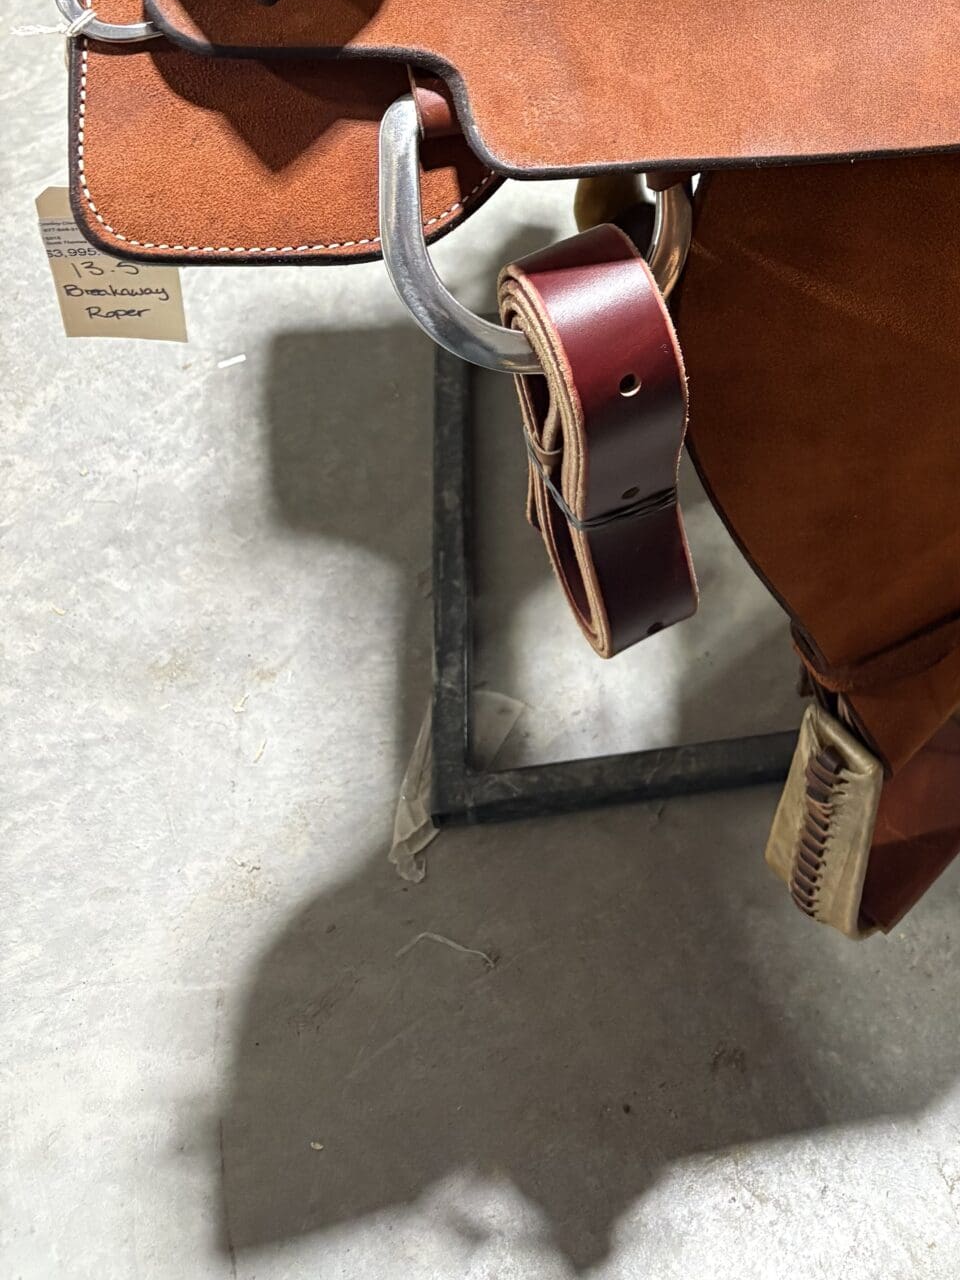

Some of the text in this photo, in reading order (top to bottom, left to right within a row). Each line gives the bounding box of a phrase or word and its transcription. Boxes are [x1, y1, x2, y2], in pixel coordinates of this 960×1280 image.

[71, 261, 139, 278] 13.5
[63, 285, 169, 301] Breakaway
[85, 306, 151, 320] Roper
